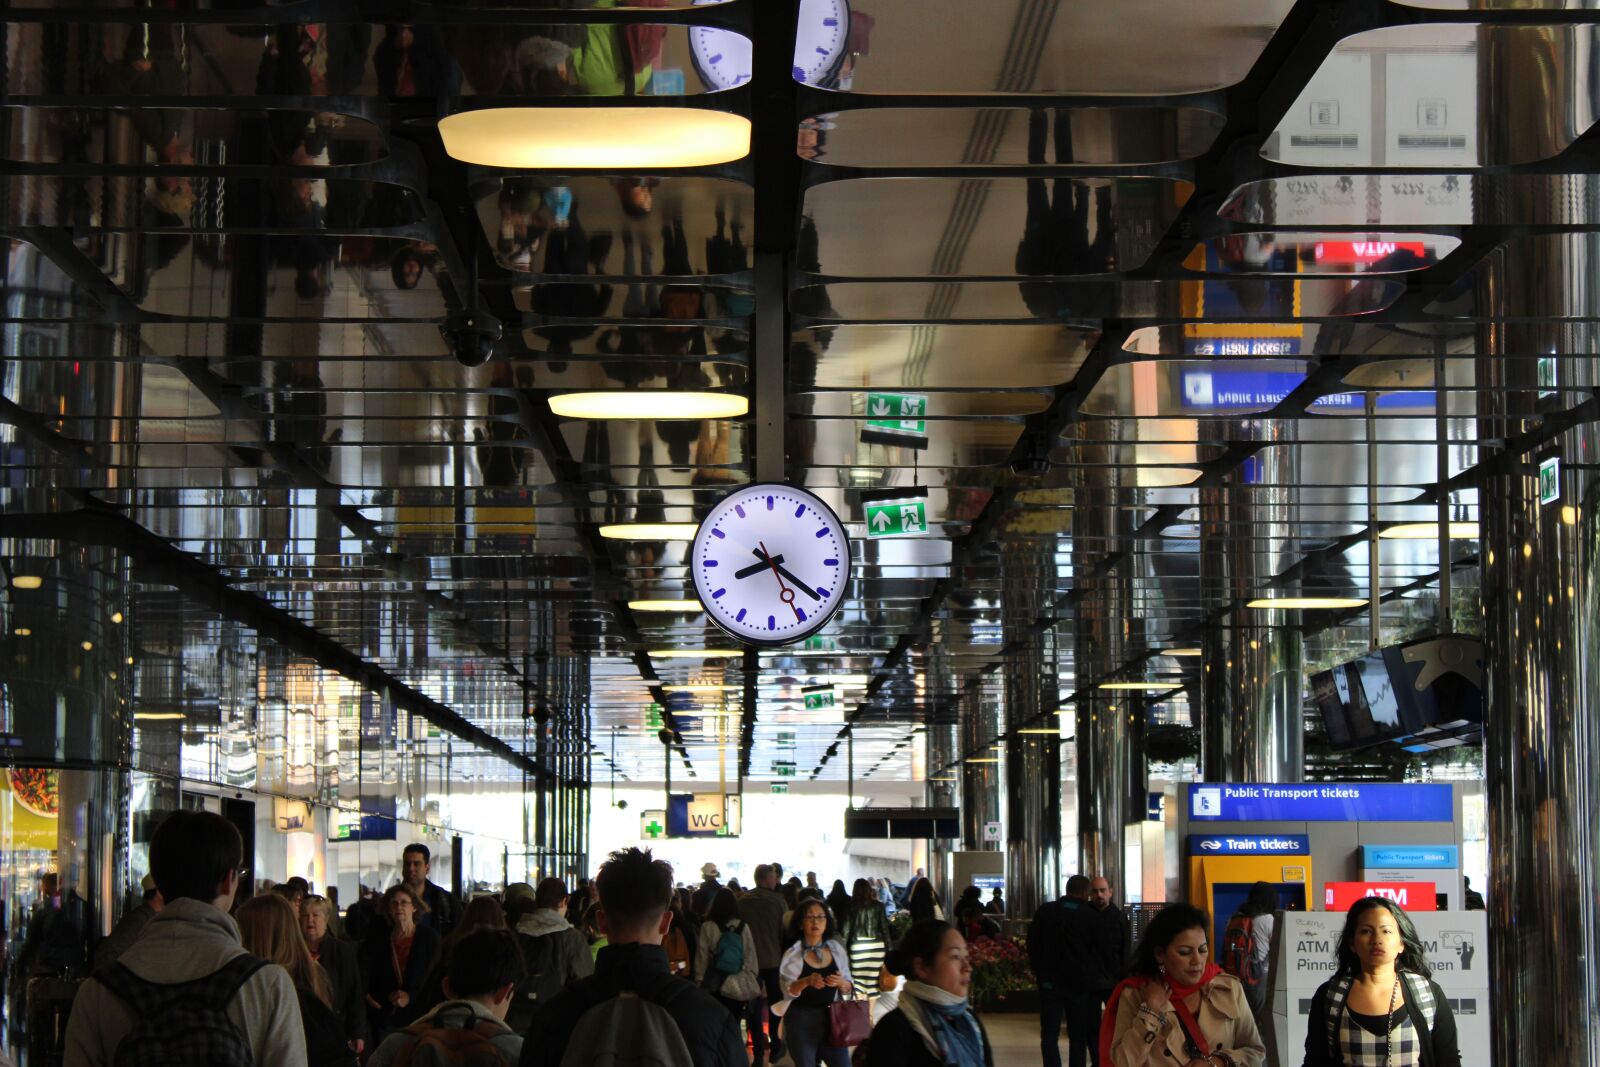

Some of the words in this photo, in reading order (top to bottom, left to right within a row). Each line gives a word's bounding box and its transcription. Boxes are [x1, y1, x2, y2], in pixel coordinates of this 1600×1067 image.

[1225, 787, 1260, 798] Public
[1262, 787, 1319, 800] Transport
[1321, 787, 1360, 798] tickets
[691, 813, 721, 828] WC
[1226, 838, 1257, 850] Train
[1259, 838, 1300, 850] tickets
[1296, 940, 1329, 953] ATM
[1297, 958, 1337, 971] Pinne
